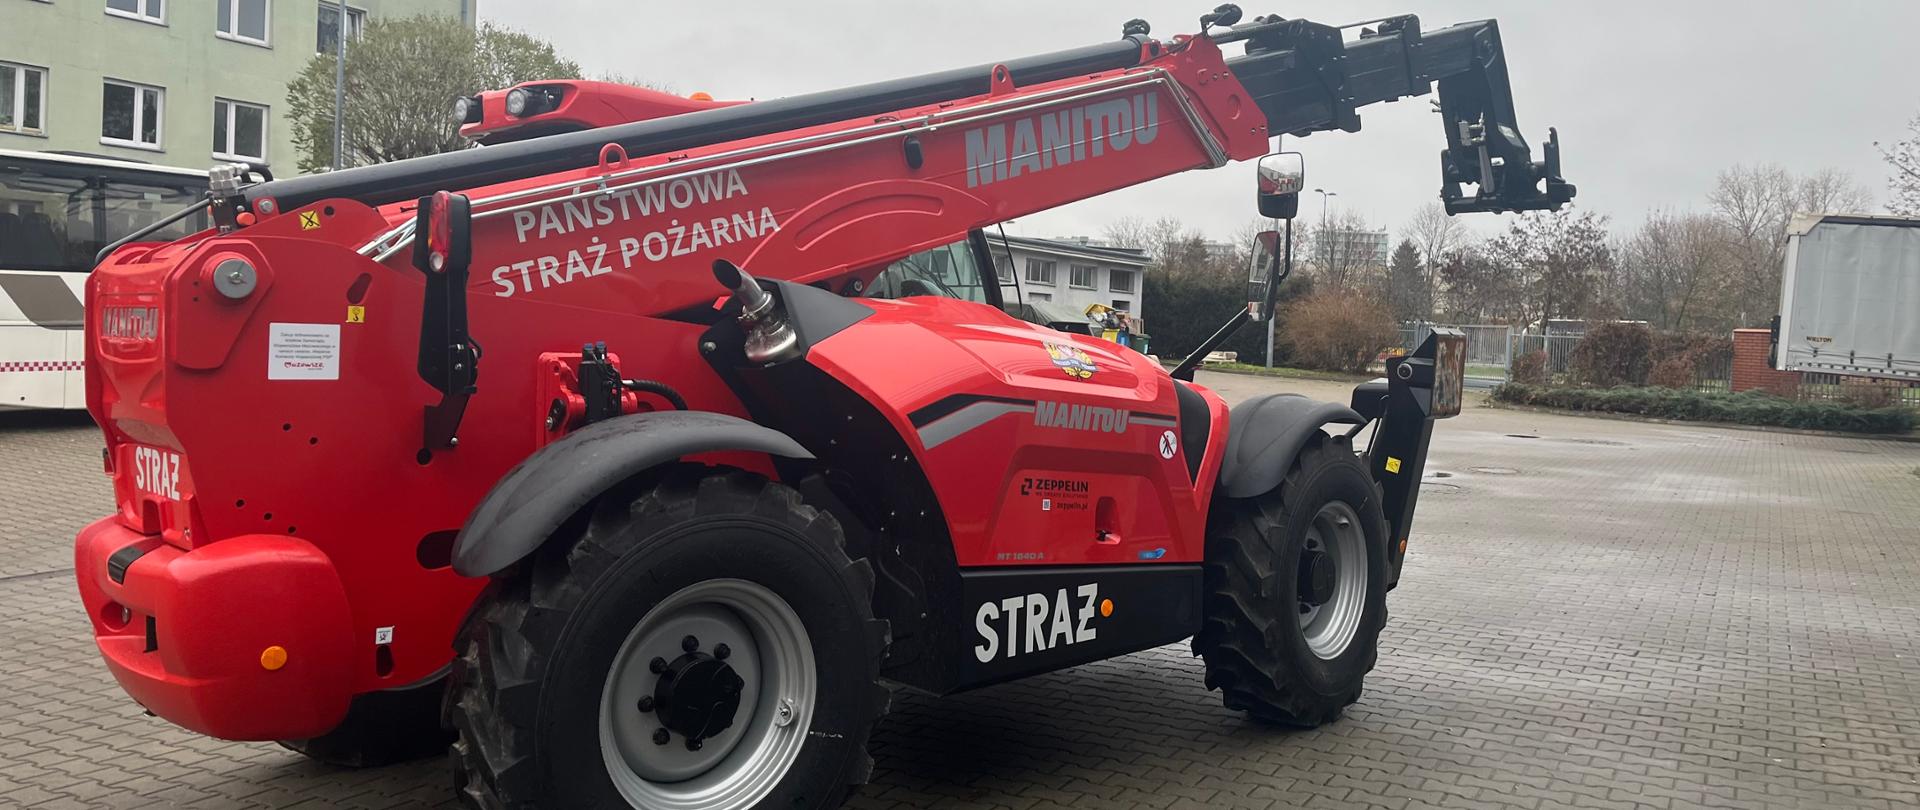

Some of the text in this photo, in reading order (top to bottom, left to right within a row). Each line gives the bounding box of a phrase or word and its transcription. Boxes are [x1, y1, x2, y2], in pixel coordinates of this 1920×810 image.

[965, 92, 1158, 188] MANITOU
[513, 168, 749, 244] PAŃSTWOWA
[491, 206, 782, 298] STRAŻ POŻARNA
[103, 306, 159, 340] MANITOU
[1034, 400, 1129, 434] MANITOU
[1036, 479, 1088, 492] ZEPPELIN
